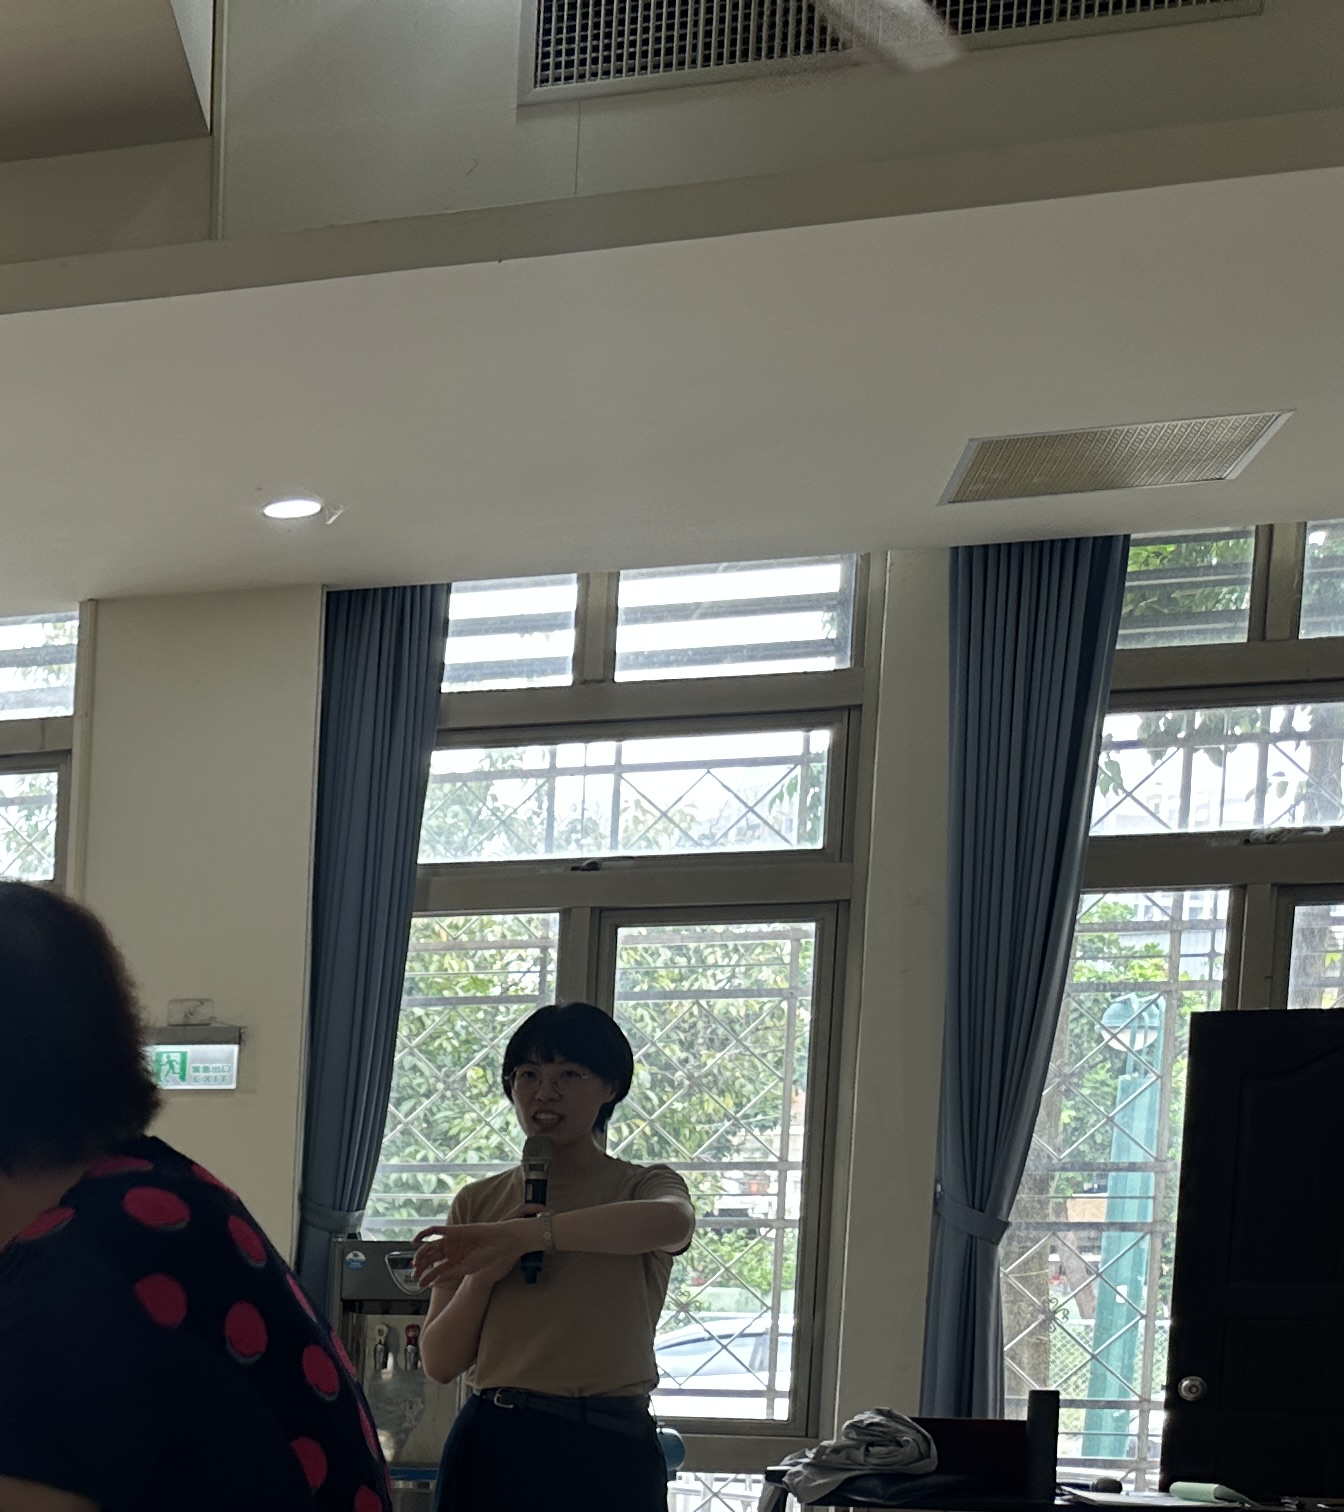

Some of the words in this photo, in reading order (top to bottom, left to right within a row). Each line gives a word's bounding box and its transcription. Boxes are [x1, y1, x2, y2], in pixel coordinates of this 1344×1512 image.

[191, 1064, 232, 1074] 緊急出口
[193, 1075, 228, 1083] EXIT
